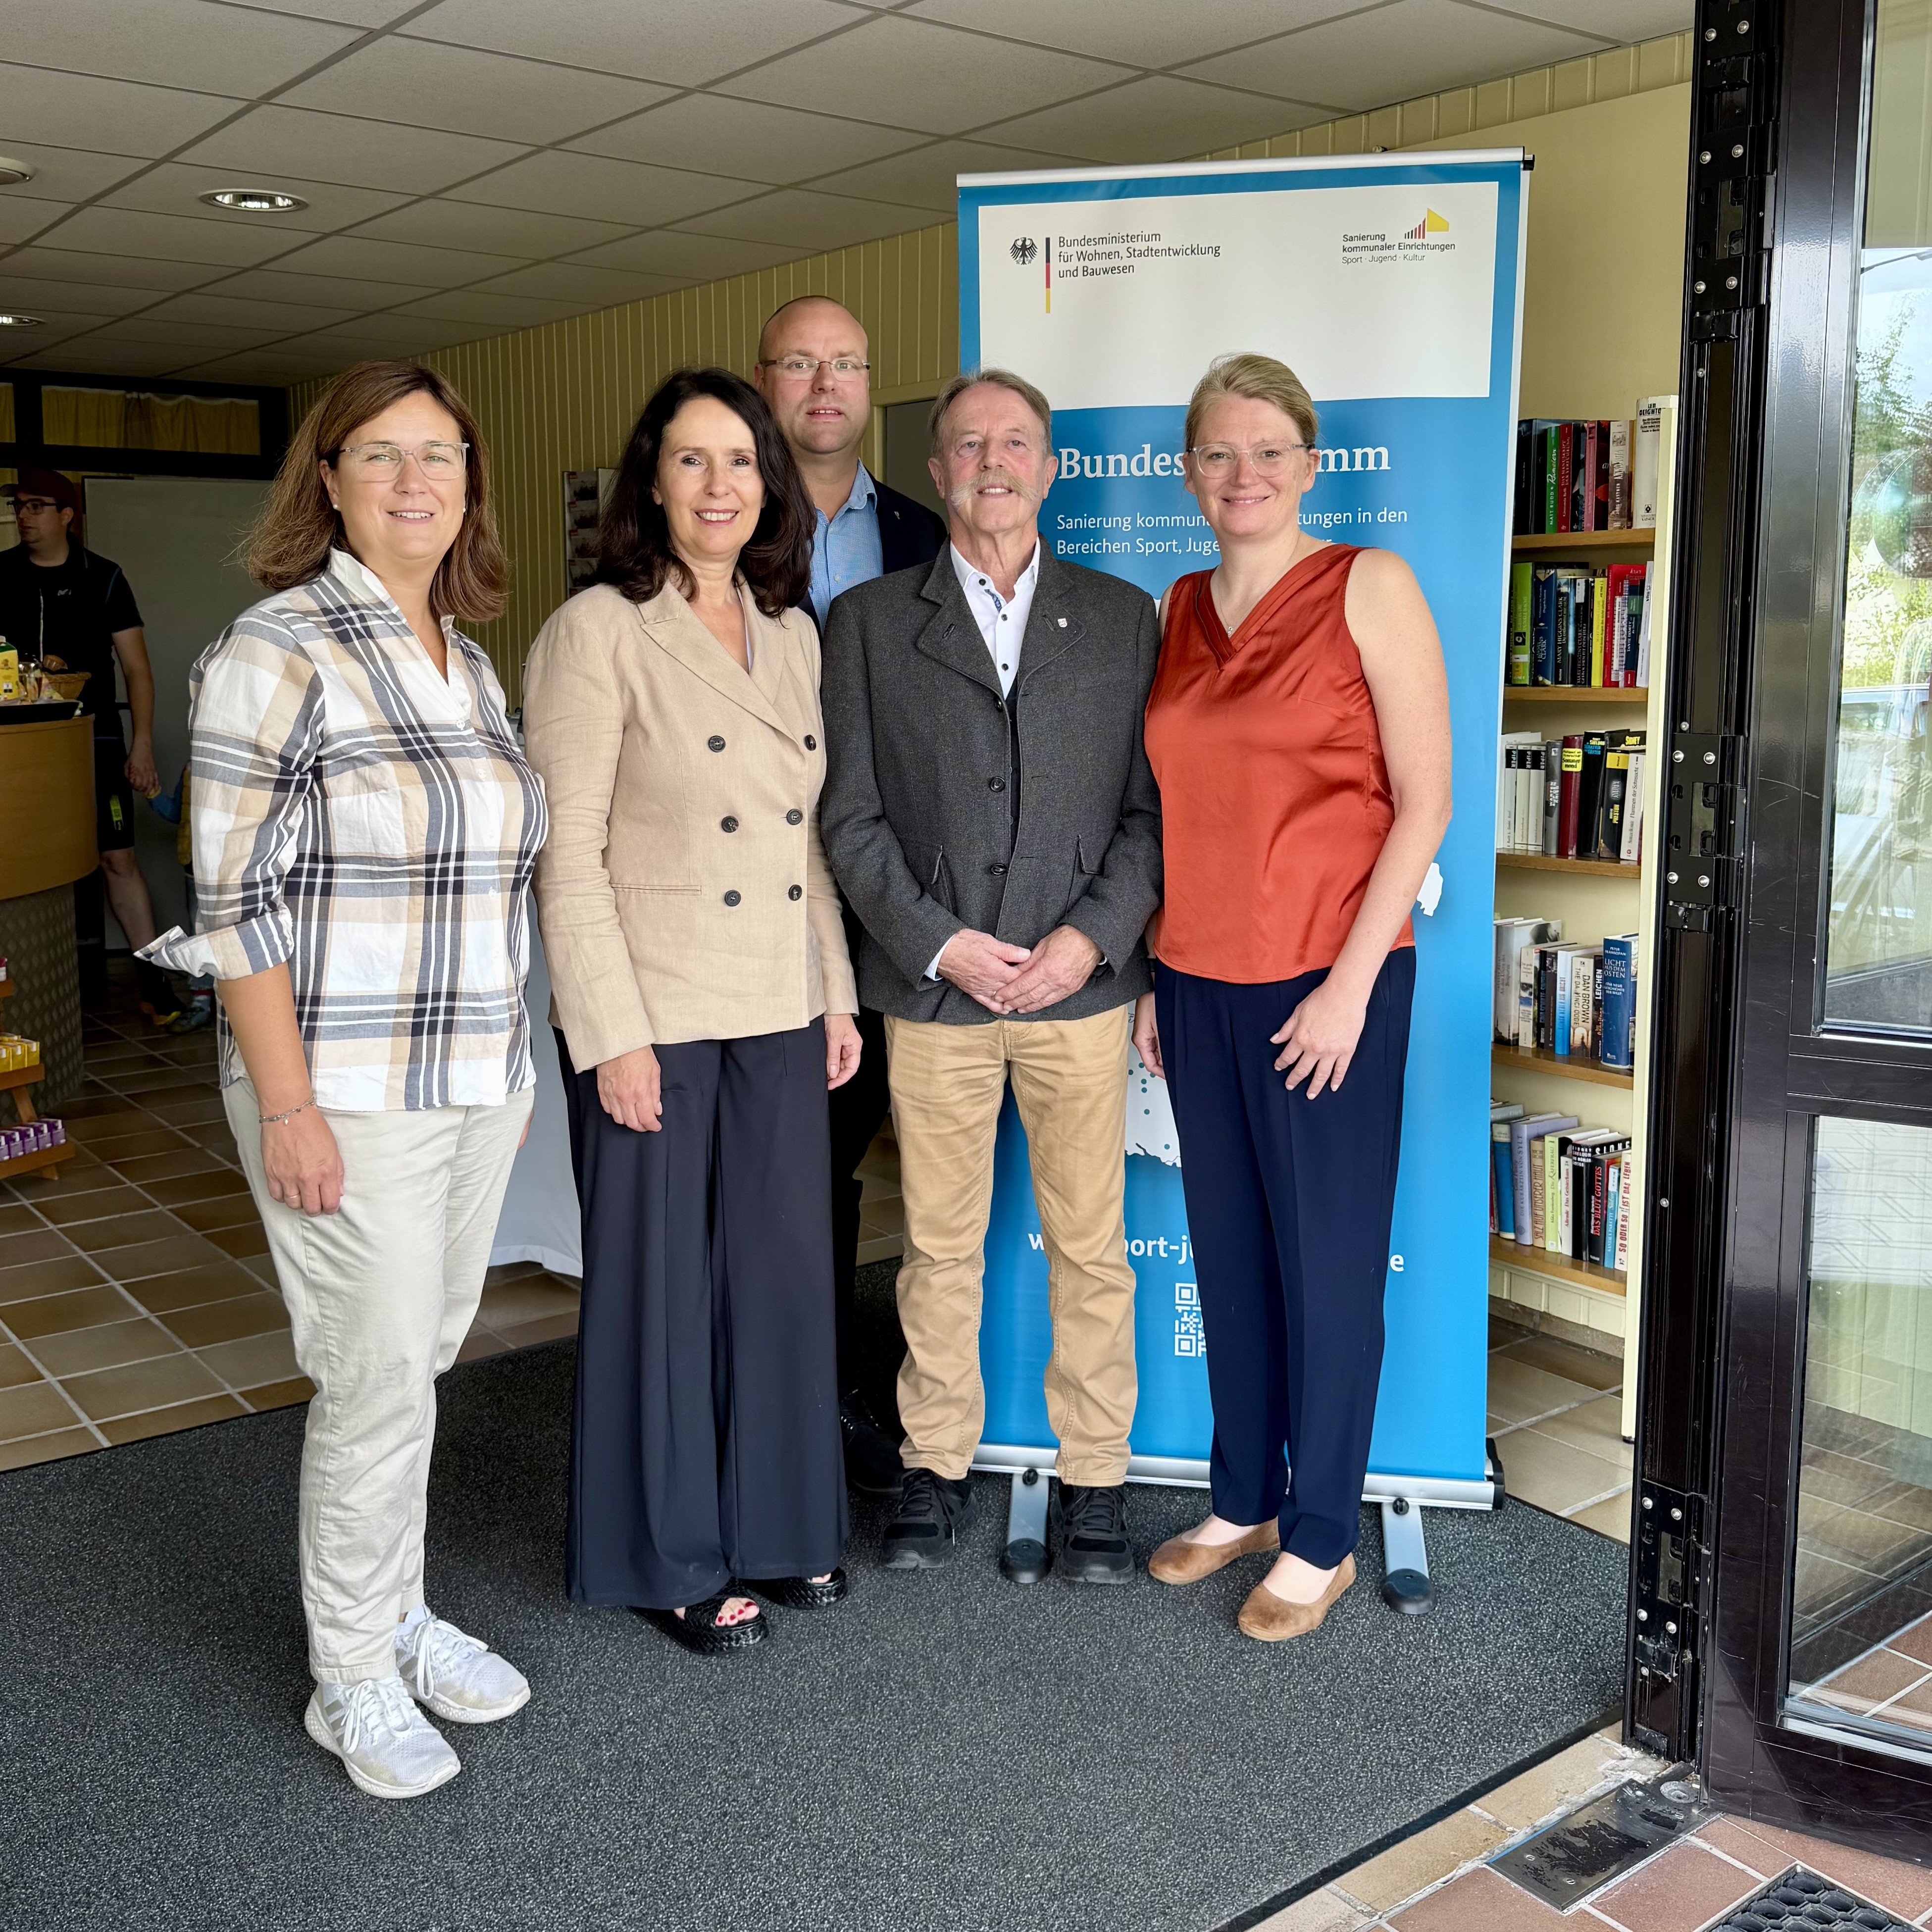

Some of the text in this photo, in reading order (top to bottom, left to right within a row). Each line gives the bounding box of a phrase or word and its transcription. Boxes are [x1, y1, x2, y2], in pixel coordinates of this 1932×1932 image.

[1059, 231, 1161, 248] Bundesministerium
[1342, 234, 1386, 242] Sanierung
[1059, 244, 1221, 263] für Wohnen, Stadtentwicklung
[1342, 242, 1456, 253] kommunaler Einrichtungen
[1342, 256, 1363, 265] Sport
[1369, 254, 1397, 264] Jugend
[1059, 264, 1134, 278] und Bauwesen
[1057, 513, 1132, 531] Sanierung
[1358, 508, 1372, 523] in
[1376, 507, 1407, 523] den
[1057, 537, 1221, 557] Bereichen Sport, Juge
[1604, 958, 1627, 967] LICHT
[1604, 970, 1626, 978] OSTEN
[1581, 974, 1590, 1023] DAN BROWN
[1623, 1161, 1631, 1180] LEBEN
[1622, 1214, 1628, 1222] SO
[1619, 1243, 1626, 1253] SO
